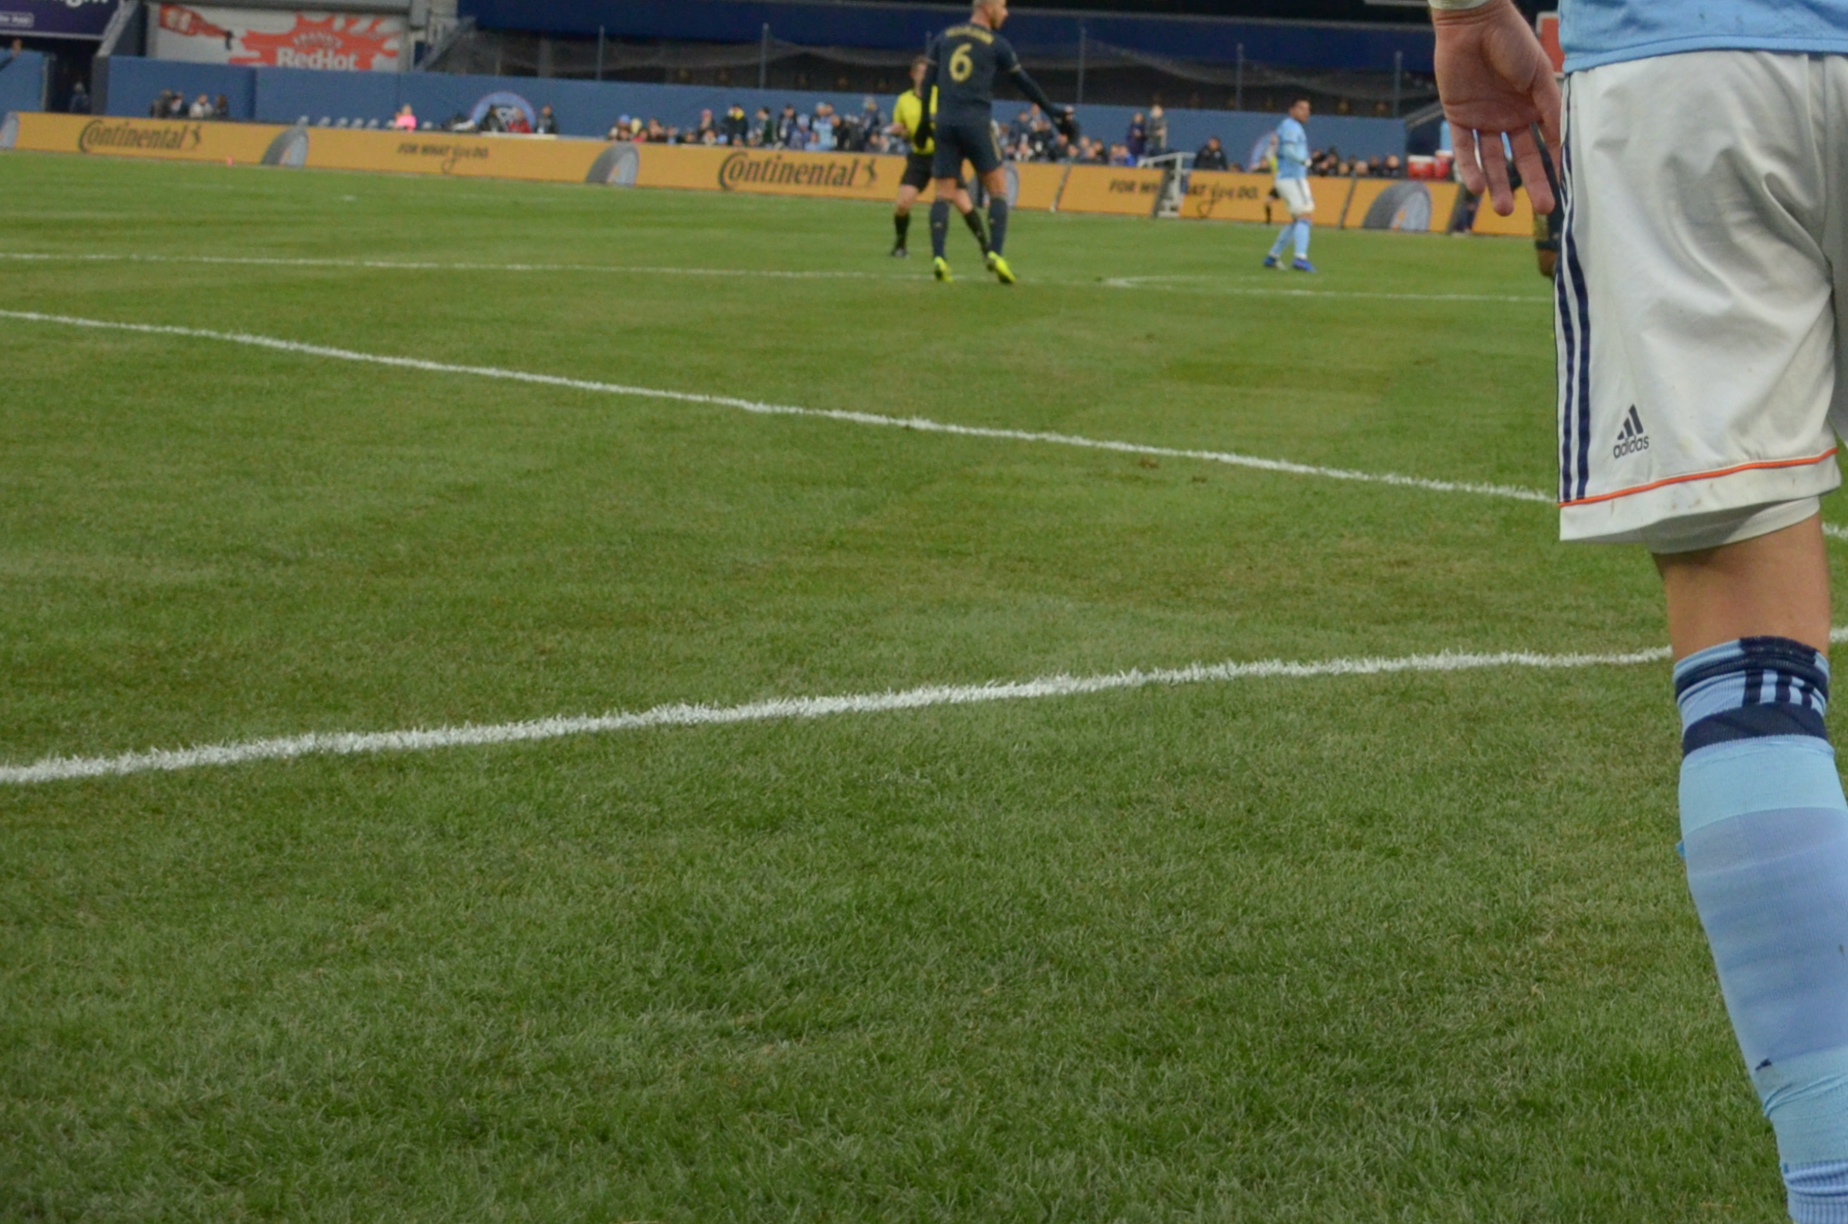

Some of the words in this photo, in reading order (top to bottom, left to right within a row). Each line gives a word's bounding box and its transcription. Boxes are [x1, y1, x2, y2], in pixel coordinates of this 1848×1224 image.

[277, 47, 357, 70] RedHot
[950, 43, 973, 82] 6
[80, 119, 188, 153] Continental
[718, 152, 860, 189] Continental
[1613, 435, 1650, 460] adidas
